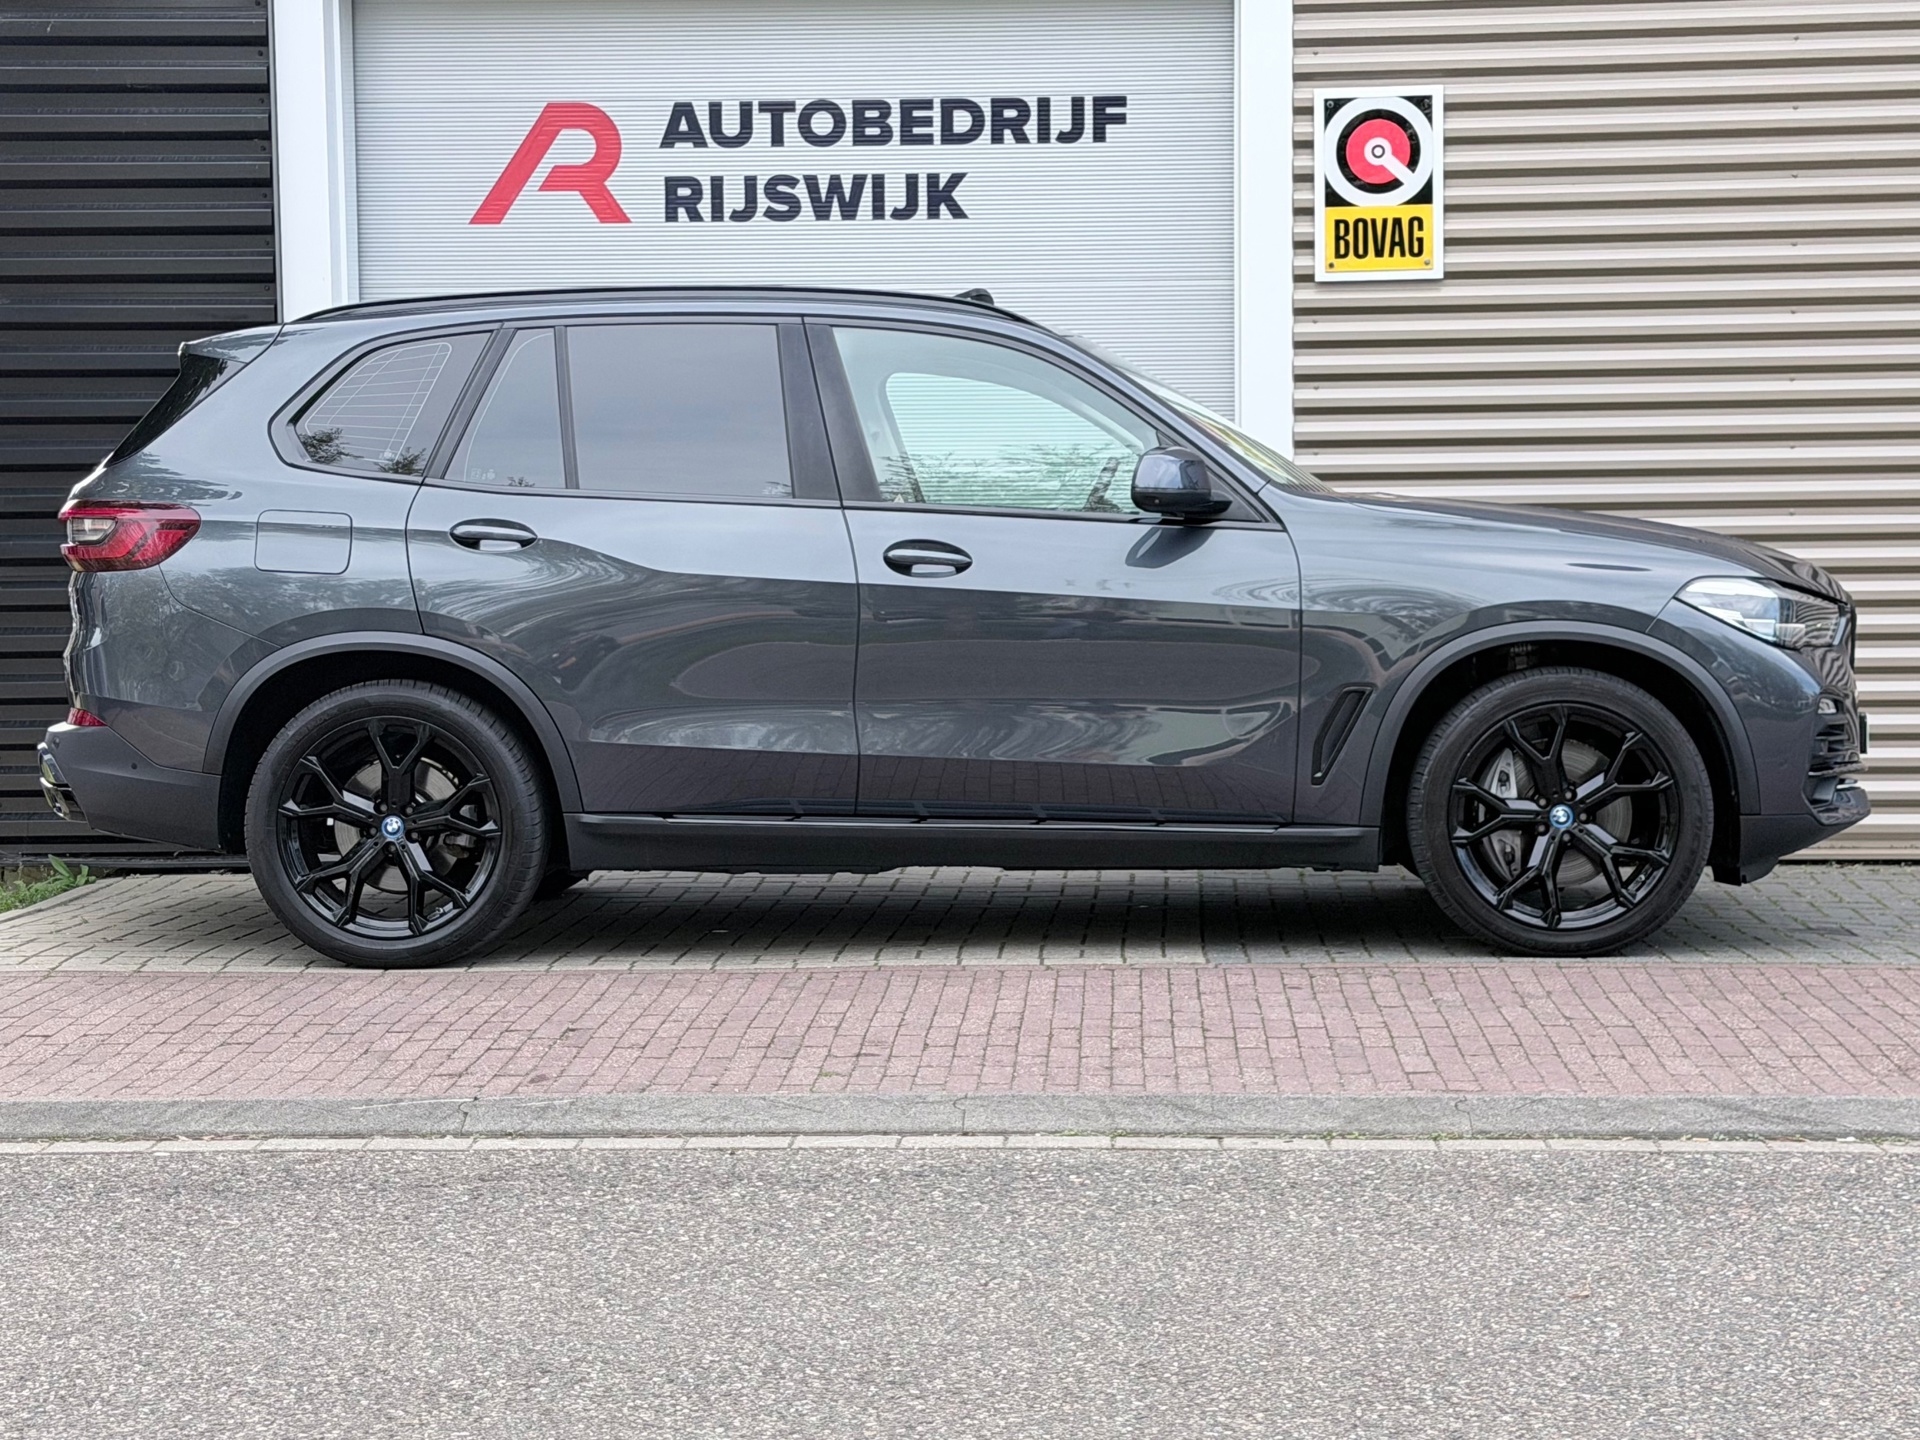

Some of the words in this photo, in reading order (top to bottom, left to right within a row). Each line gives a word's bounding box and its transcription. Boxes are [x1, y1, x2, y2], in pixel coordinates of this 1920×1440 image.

[659, 95, 1127, 149] AUTOBEDRIJF
[664, 172, 969, 223] RIJSWIJK
[1334, 216, 1424, 259] BOVAG
